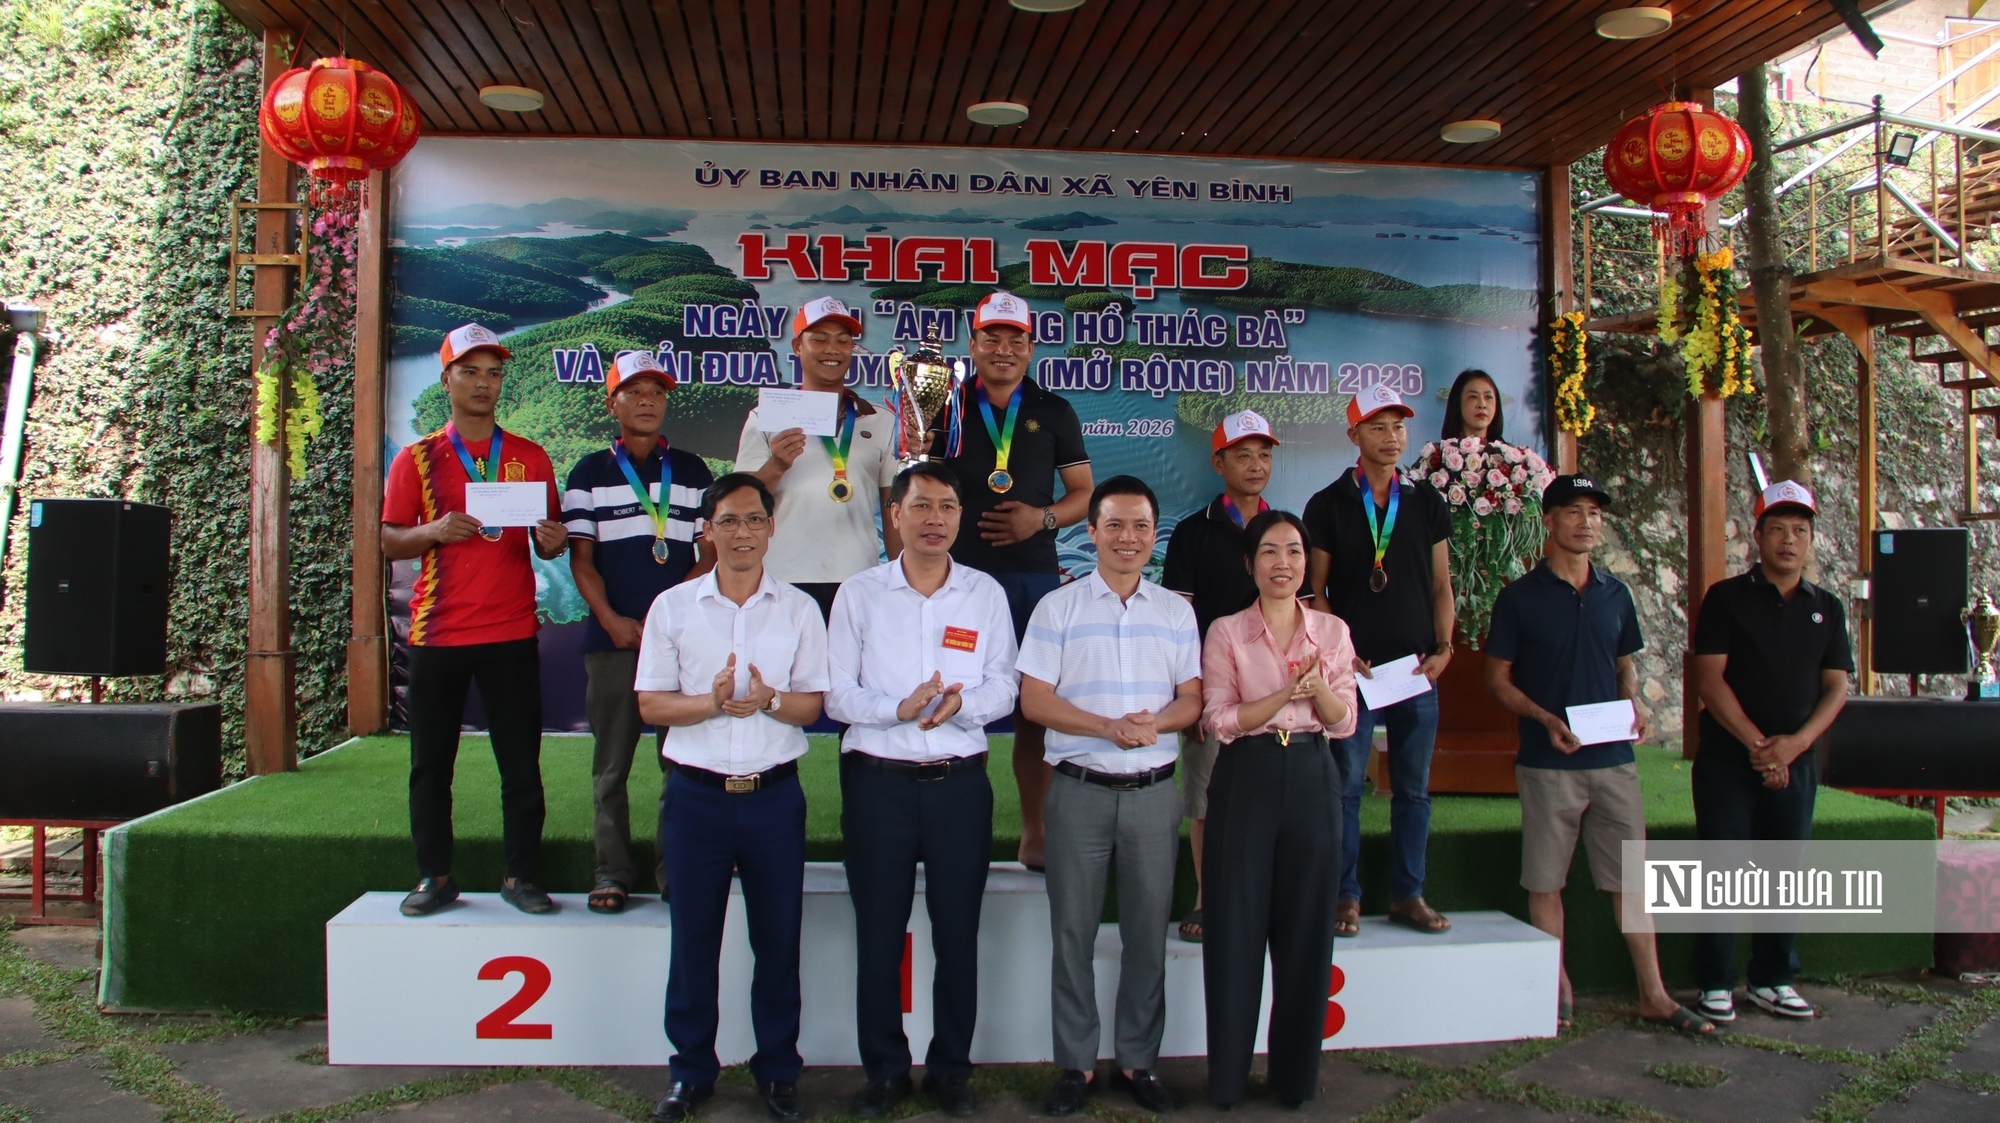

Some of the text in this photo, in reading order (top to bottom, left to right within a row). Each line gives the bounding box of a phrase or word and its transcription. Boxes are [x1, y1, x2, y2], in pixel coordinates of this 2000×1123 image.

[694, 160, 1293, 203] ỦY BAN NHÂN DÂN XÃ YÊN BÌNH
[736, 232, 1249, 300] KHAI MẠC
[683, 299, 788, 338] NGÀY
[1073, 303, 1125, 345] HỒ
[1132, 308, 1227, 347] THÁC
[553, 343, 605, 383] VÀ
[614, 340, 693, 384] ẢI
[701, 350, 779, 386] ĐUA
[1121, 352, 1235, 398] RỘNG)
[1245, 355, 1330, 394] NĂM
[1337, 362, 1424, 395] 2026
[1082, 418, 1175, 437] năm 2026
[613, 506, 636, 516] ROBERT
[476, 955, 552, 1039] 2
